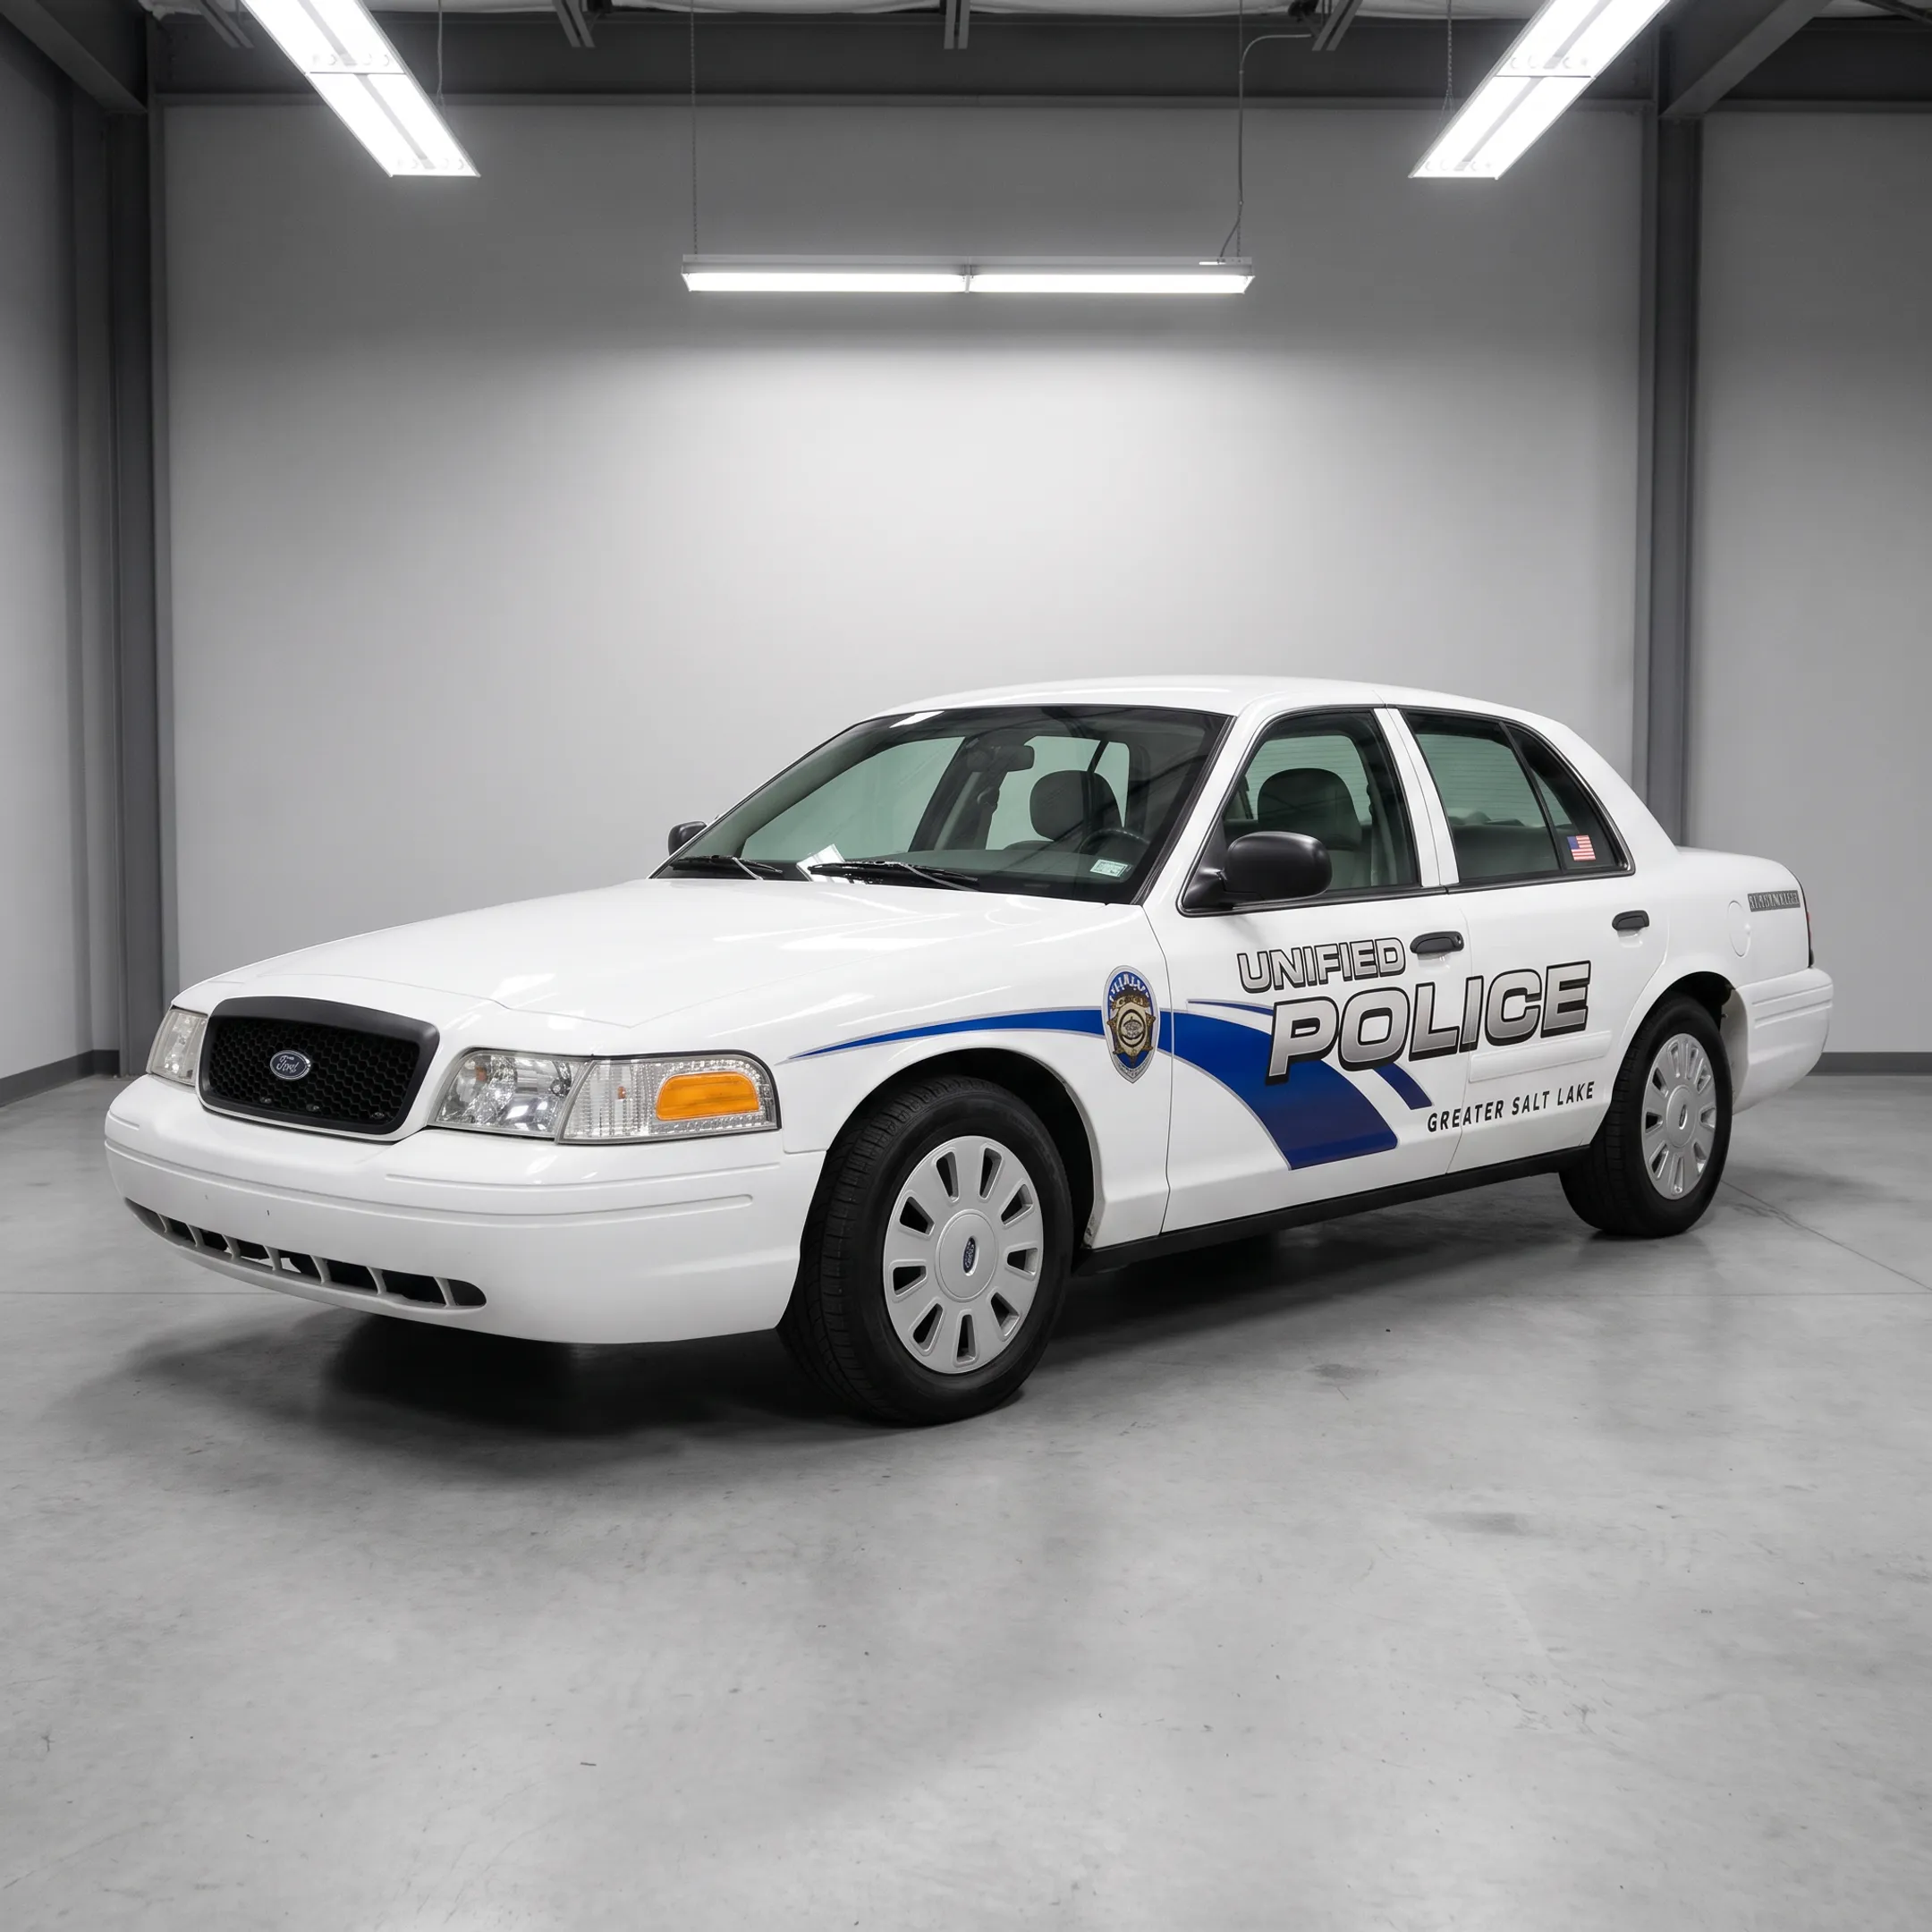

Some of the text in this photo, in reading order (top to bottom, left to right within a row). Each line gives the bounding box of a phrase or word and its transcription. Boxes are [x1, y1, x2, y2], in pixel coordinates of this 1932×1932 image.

[1236, 937, 1406, 993] UNIFIED
[1265, 960, 1591, 1086] POLICE
[1428, 1081, 1595, 1132] GREATER SALT LAKE
